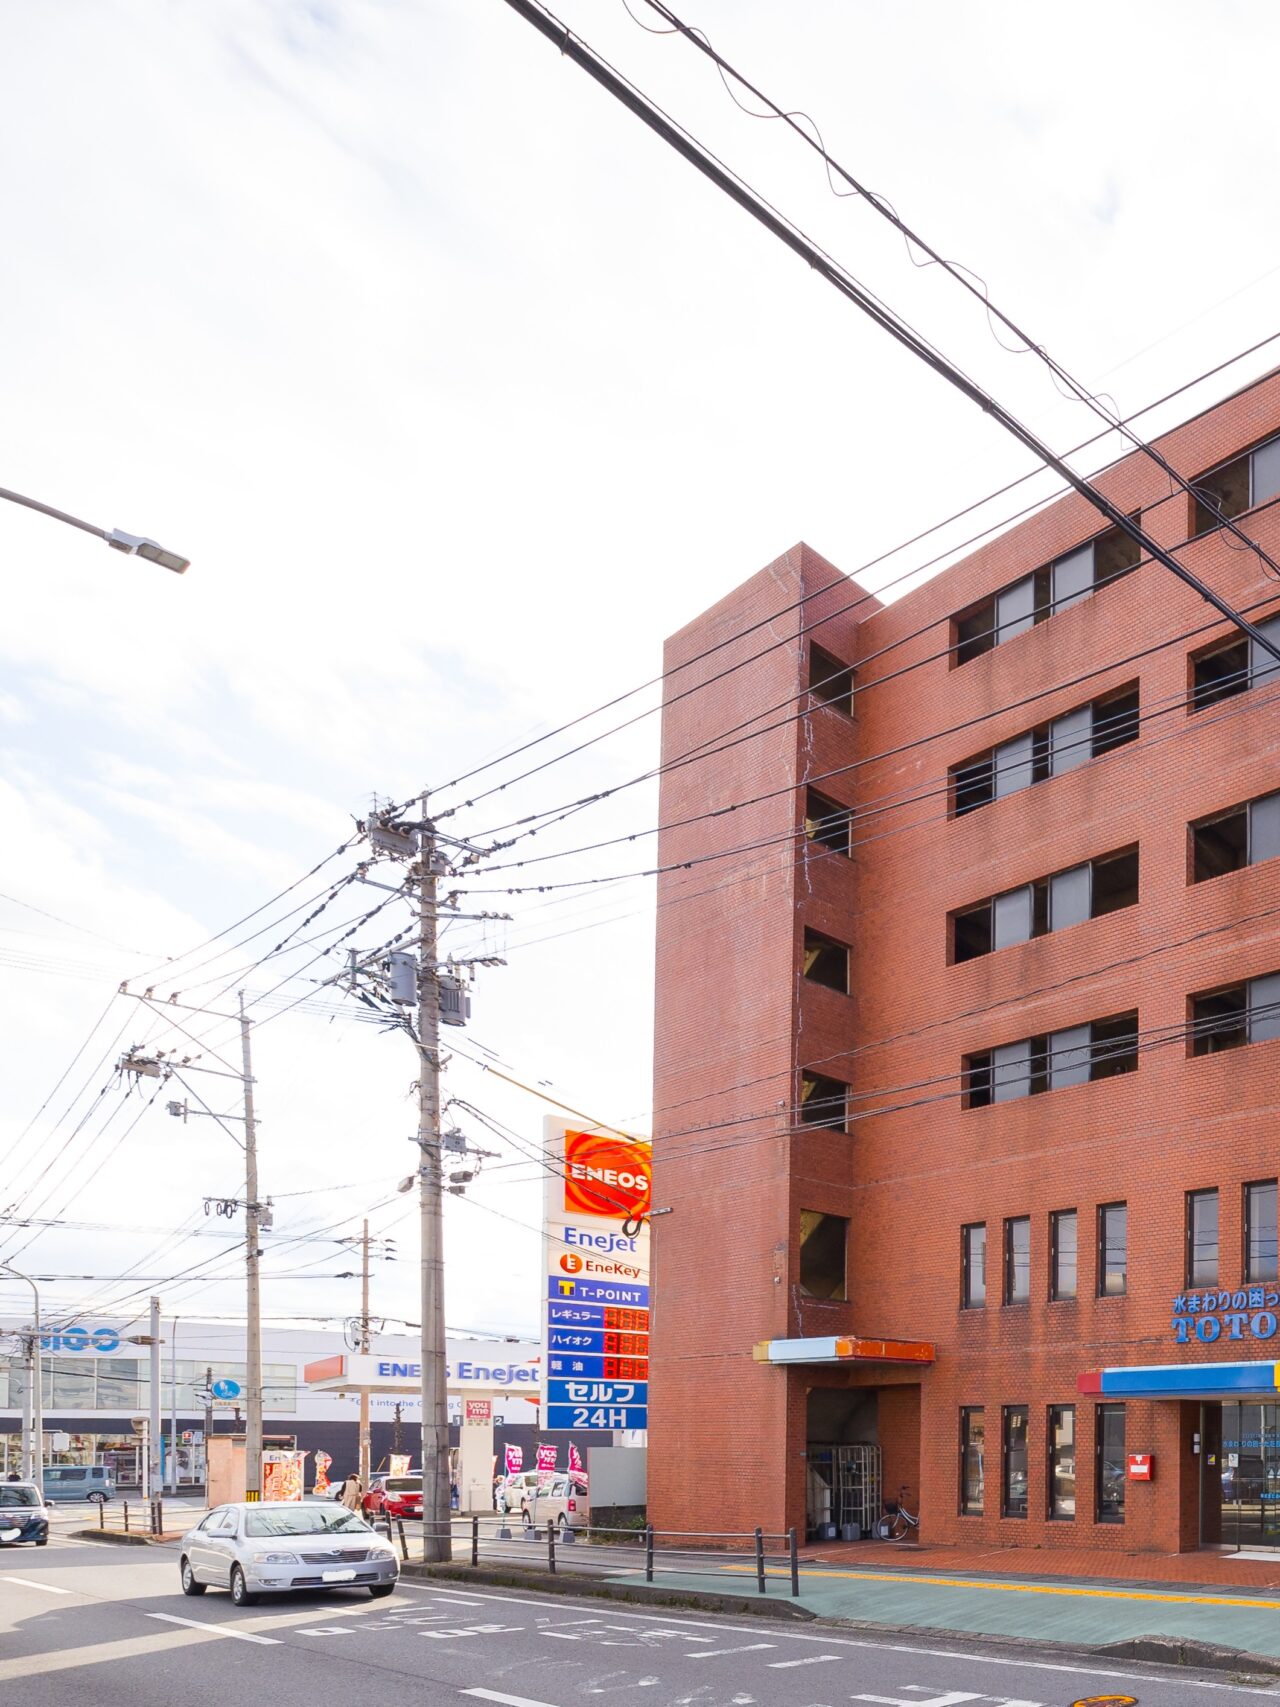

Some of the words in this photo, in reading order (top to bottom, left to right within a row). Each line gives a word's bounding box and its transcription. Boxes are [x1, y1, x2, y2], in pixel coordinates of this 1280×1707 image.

[571, 1163, 649, 1191] ENEOS
[564, 1227, 637, 1253] Enejet
[586, 1260, 641, 1279] EneKey
[580, 1287, 642, 1303] T-POINT
[551, 1309, 601, 1321] レギュラー
[551, 1335, 593, 1346] ハイオク
[378, 1362, 452, 1379] ENE
[458, 1361, 539, 1385] Enejet
[565, 1382, 635, 1402] セルフ
[468, 1402, 488, 1410] you
[572, 1408, 627, 1428] 24H
